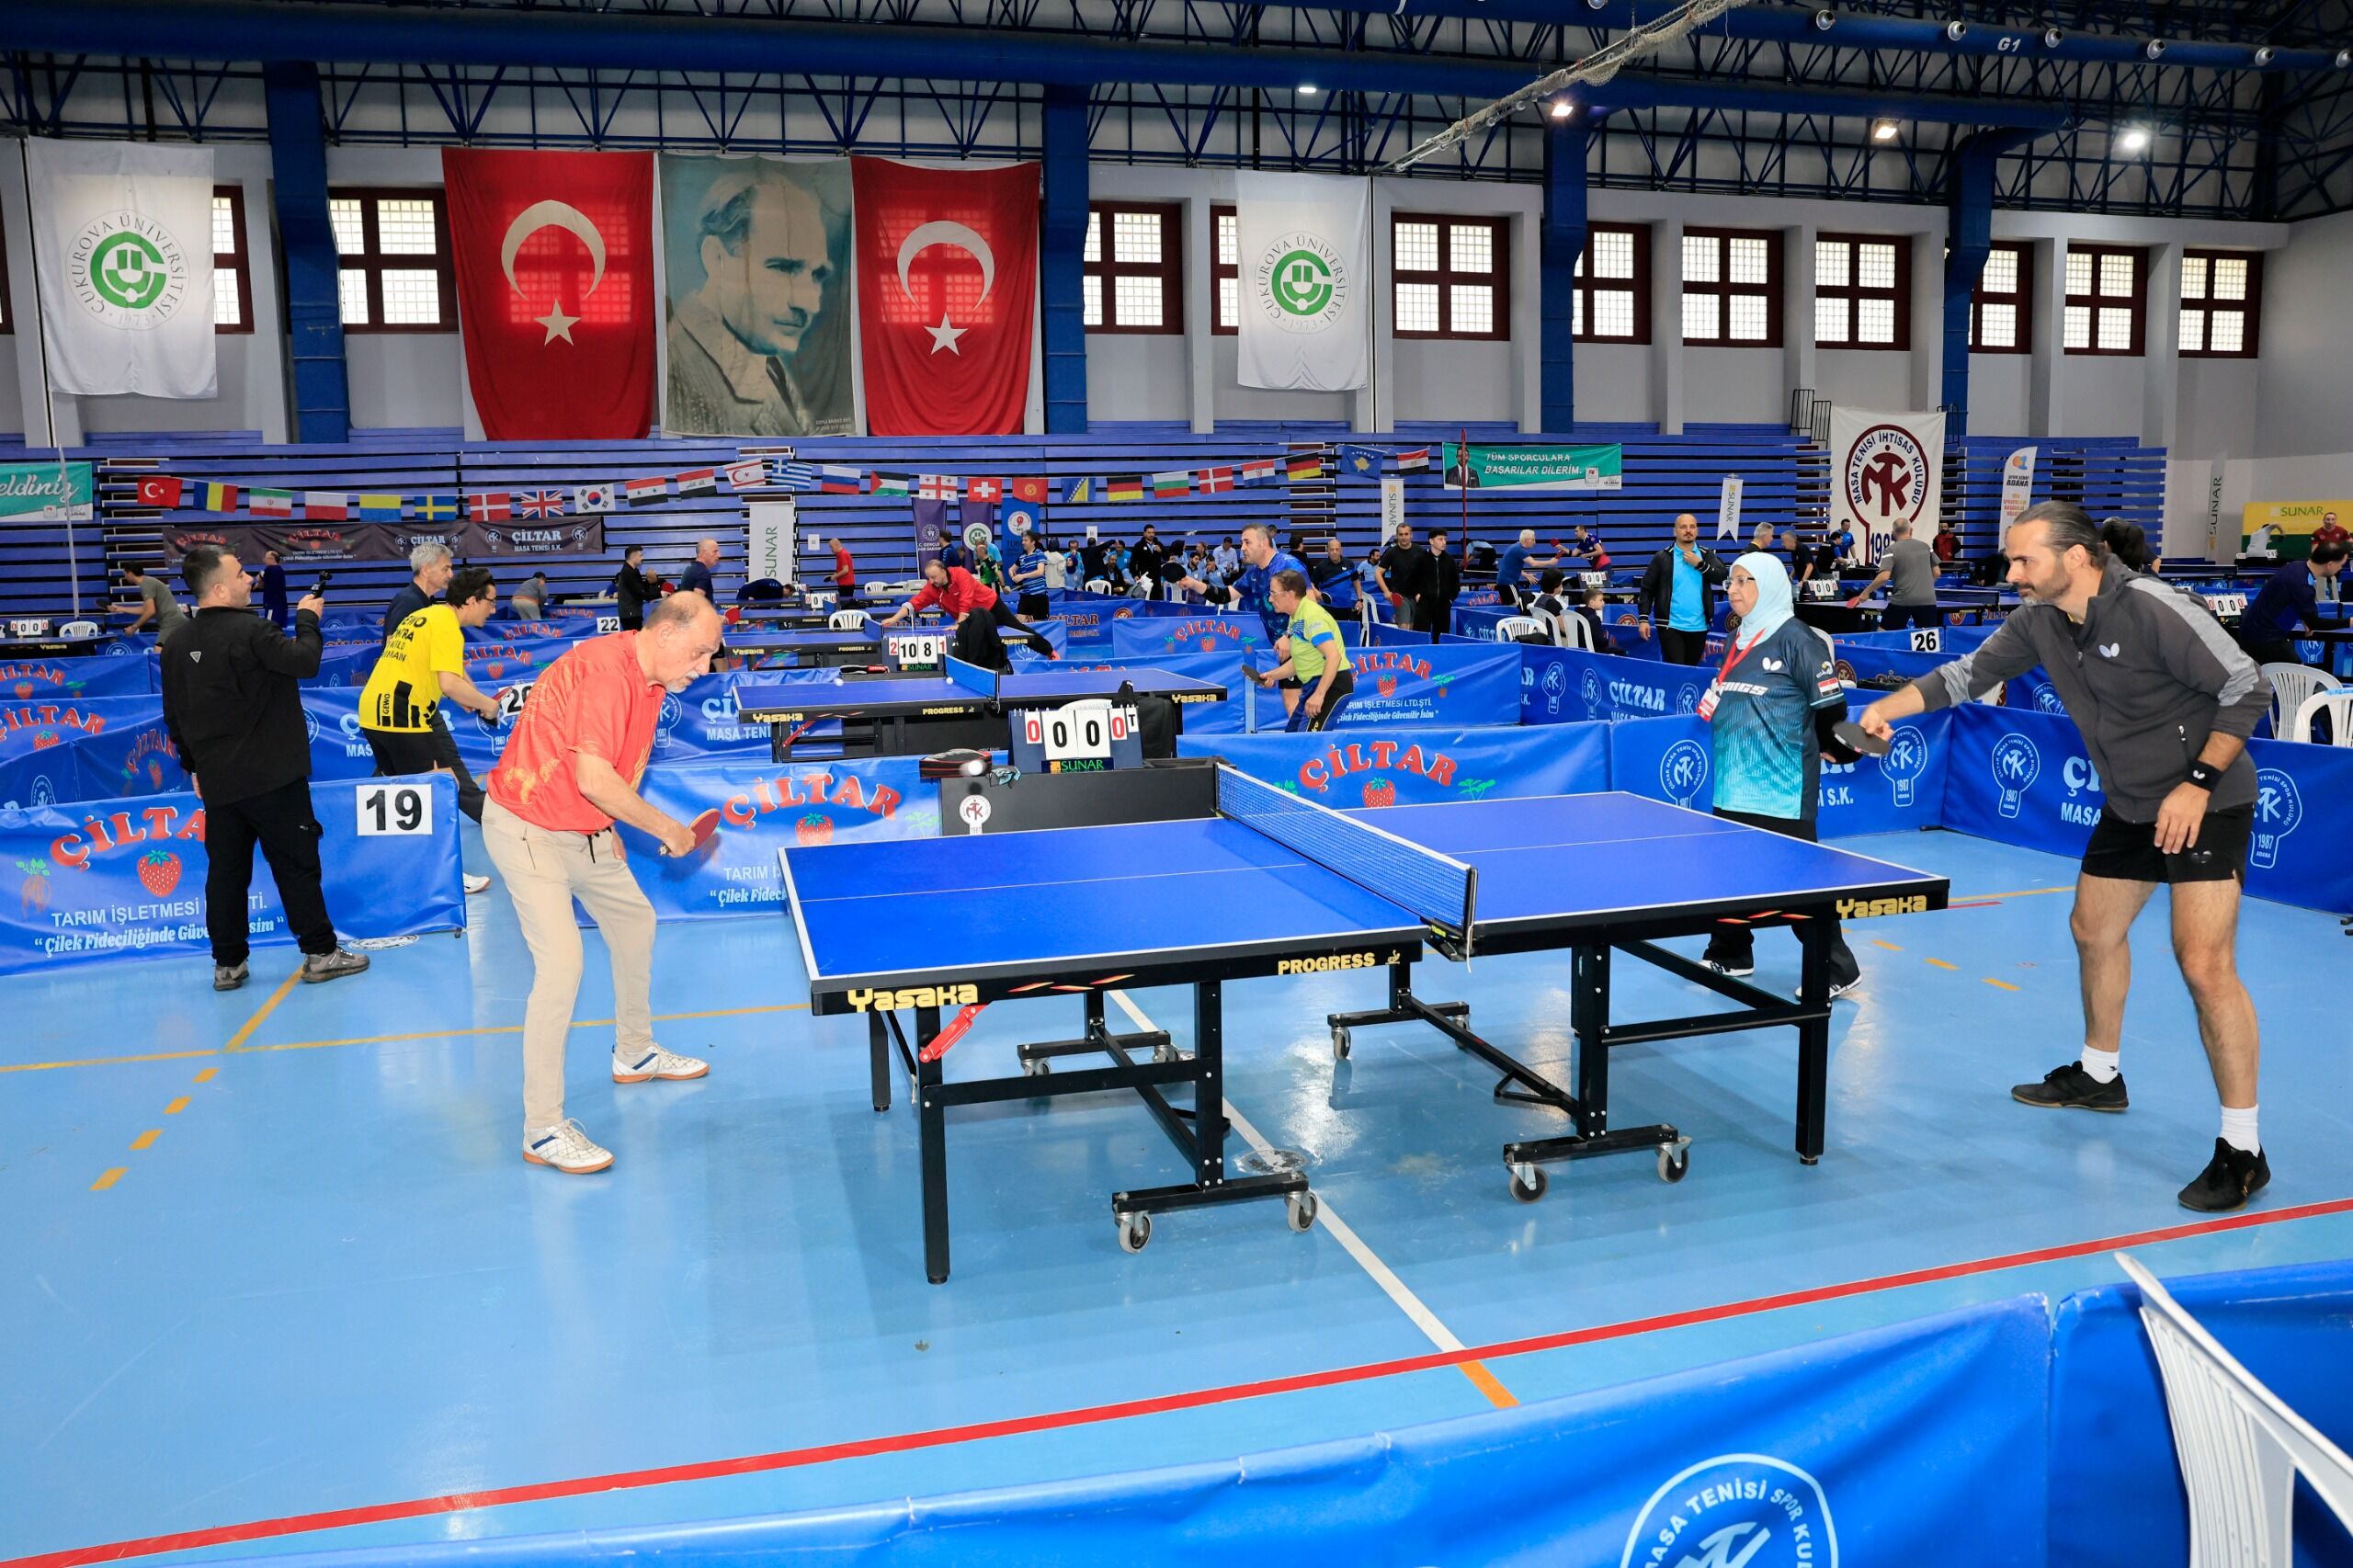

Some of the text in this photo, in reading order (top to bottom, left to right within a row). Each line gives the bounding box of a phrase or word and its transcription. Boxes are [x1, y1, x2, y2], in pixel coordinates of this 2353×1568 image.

[1997, 37, 2021, 52] G1
[1852, 433, 1876, 469] TENİSİ
[1850, 472, 1863, 505] MASA
[1388, 493, 1396, 527] SUNAR
[1726, 492, 1735, 522] SUNAR
[2209, 475, 2222, 535] SUNAR
[2280, 506, 2325, 517] SUNAR
[511, 528, 562, 545] ÇİLTAR
[765, 526, 778, 577] SUNAR
[2218, 599, 2224, 612] 0
[2230, 599, 2236, 612] 0
[600, 619, 619, 632] 22
[1174, 619, 1241, 642] ÇİLTAR
[890, 641, 945, 658] 2 10 8 1
[1915, 631, 1937, 652] 26
[1171, 693, 1218, 704] Yasaka
[1608, 677, 1665, 711] ÇİLTAR
[752, 712, 803, 724] Yasaka
[922, 706, 964, 716] PROGRESS
[706, 726, 742, 742] MASA
[1027, 714, 1136, 748] 0 0 0 0 T
[1060, 759, 1105, 772] SUNAR
[1298, 740, 1458, 792] ÇİLTAR
[722, 773, 902, 830] ÇİLTAR
[1826, 786, 1854, 807] S.K.
[364, 788, 424, 832] 19
[2061, 801, 2102, 827] MASA
[50, 806, 207, 872] ÇİLTA
[2257, 833, 2274, 850] 1987
[722, 866, 768, 881] TARIM
[718, 887, 749, 908] Çilek
[1836, 894, 1927, 920] Yasaka
[51, 908, 107, 927] TARIM
[111, 897, 199, 926] İŞLETMESİ
[45, 934, 83, 958] Çilek
[85, 926, 176, 949] Fideciliğinde
[1278, 952, 1376, 975] PROGRESS
[847, 983, 979, 1013] Yasaka
[1684, 1477, 1768, 1517] TENİSİ
[1769, 1487, 1804, 1522] SPOR
